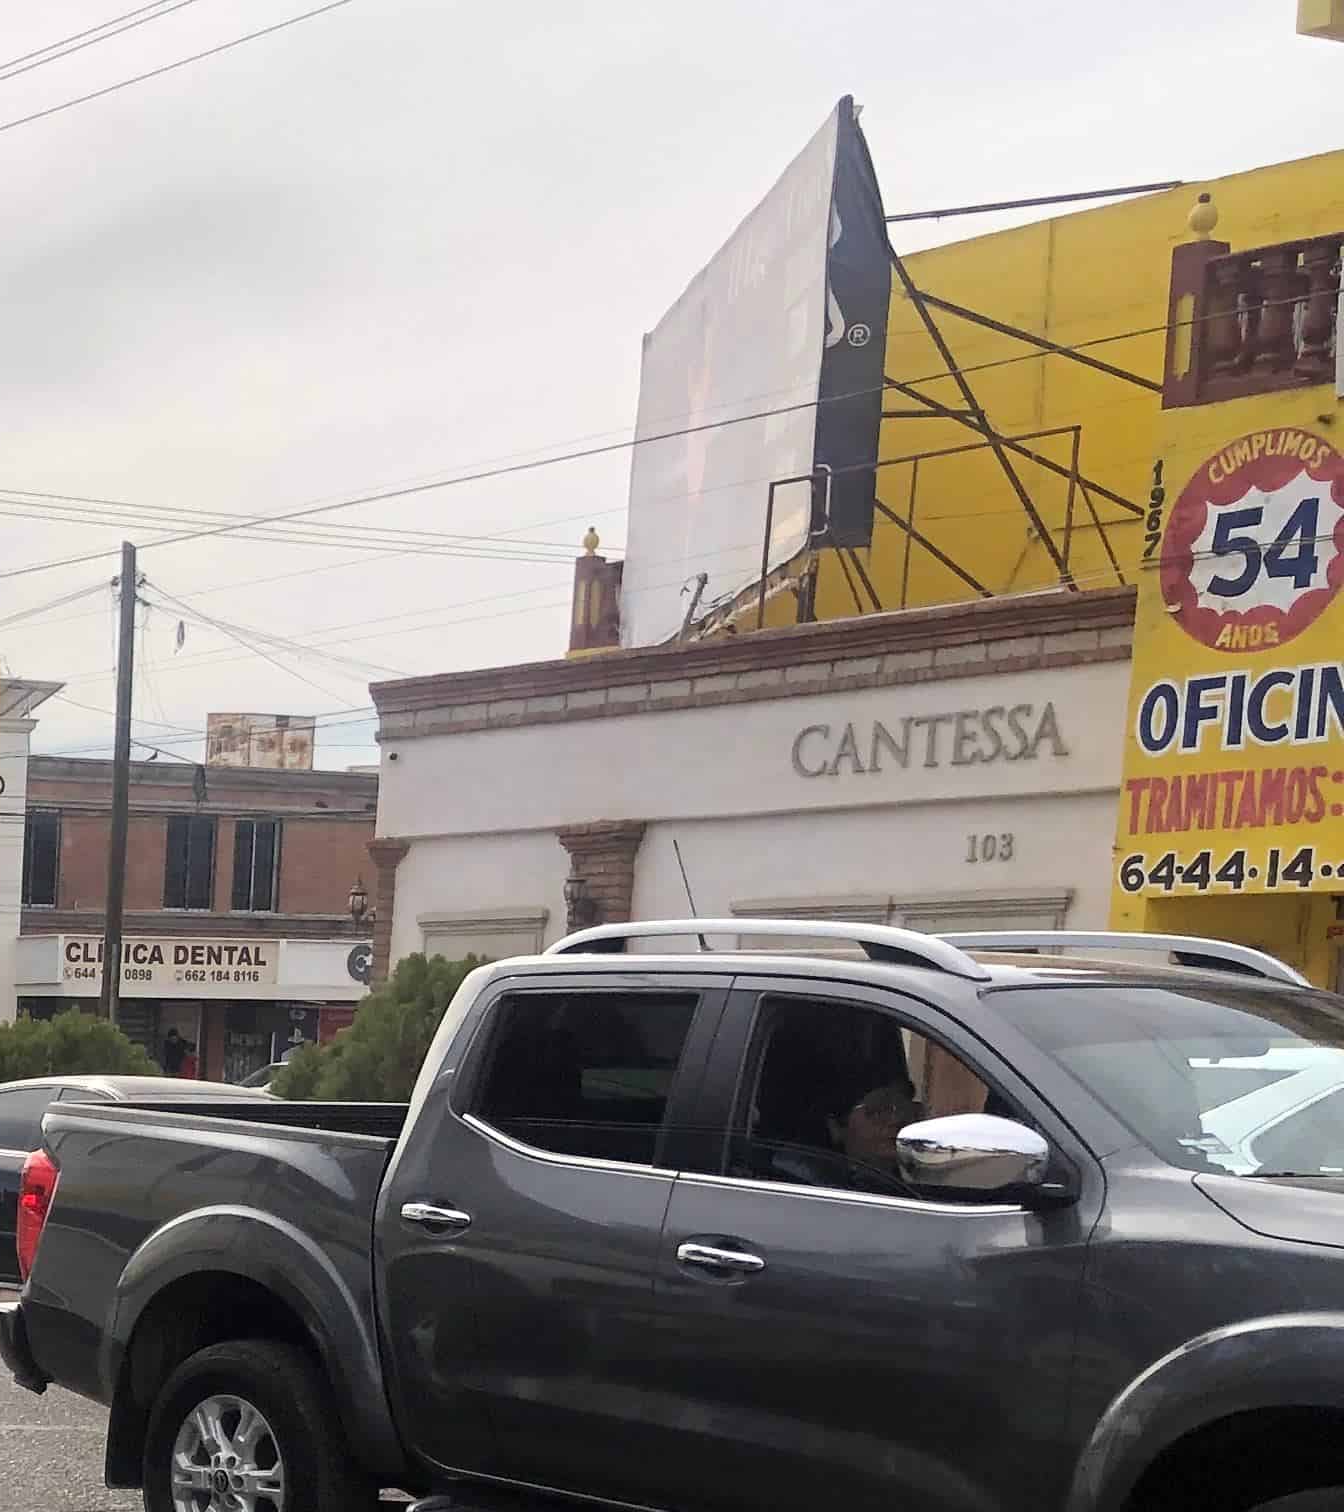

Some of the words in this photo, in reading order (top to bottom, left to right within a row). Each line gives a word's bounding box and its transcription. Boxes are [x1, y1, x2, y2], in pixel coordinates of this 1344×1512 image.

[1208, 431, 1330, 484] CUMPLIMOS
[1206, 497, 1321, 598] 54
[790, 701, 1070, 778] CANTESSA
[965, 832, 1016, 863] 103
[65, 937, 164, 964] CLÍICA
[173, 944, 267, 967] DENTAL
[184, 969, 206, 981] 662
[210, 970, 230, 981] 184
[233, 970, 260, 982] 8116
